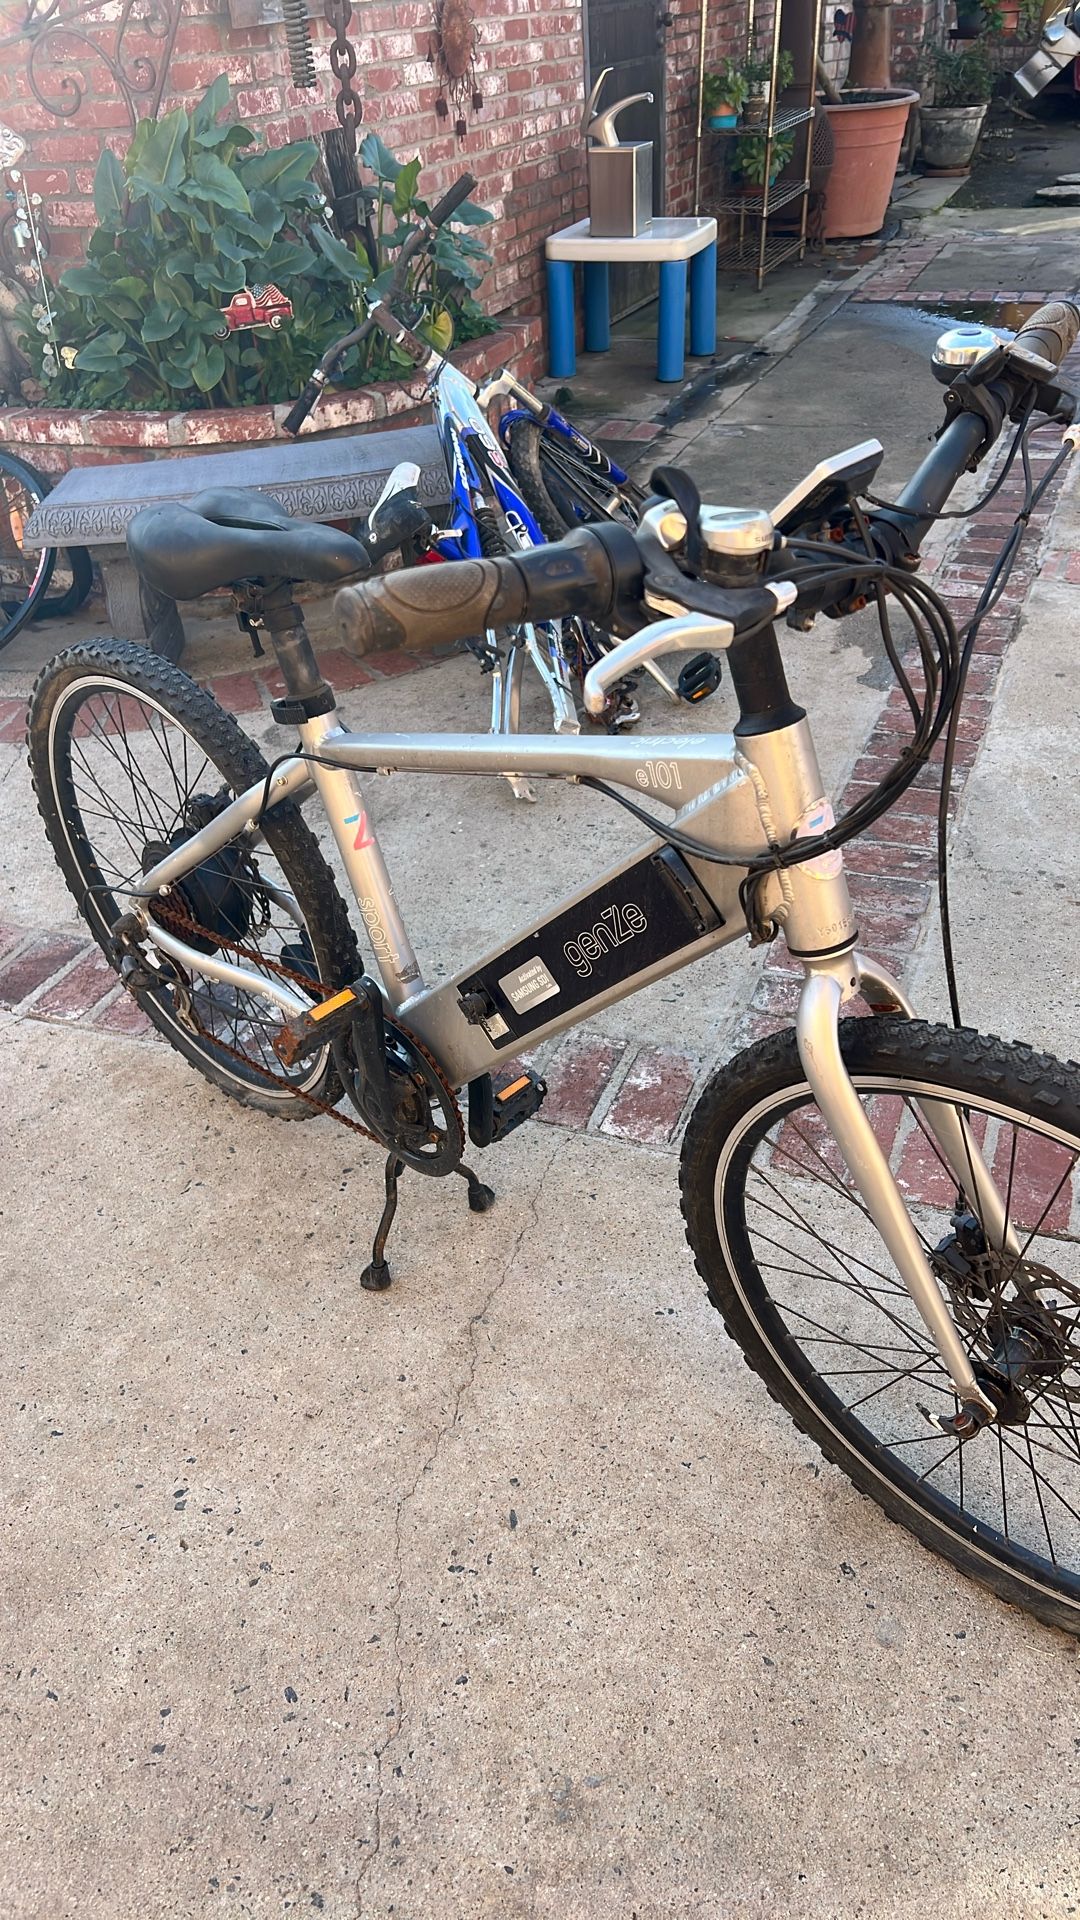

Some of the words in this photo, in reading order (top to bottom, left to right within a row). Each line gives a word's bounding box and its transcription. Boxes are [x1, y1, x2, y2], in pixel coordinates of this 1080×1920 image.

[635, 761, 682, 790] e101
[358, 897, 400, 964] sport
[510, 979, 540, 1003] SAMSUNG
[536, 973, 550, 987] SDI
